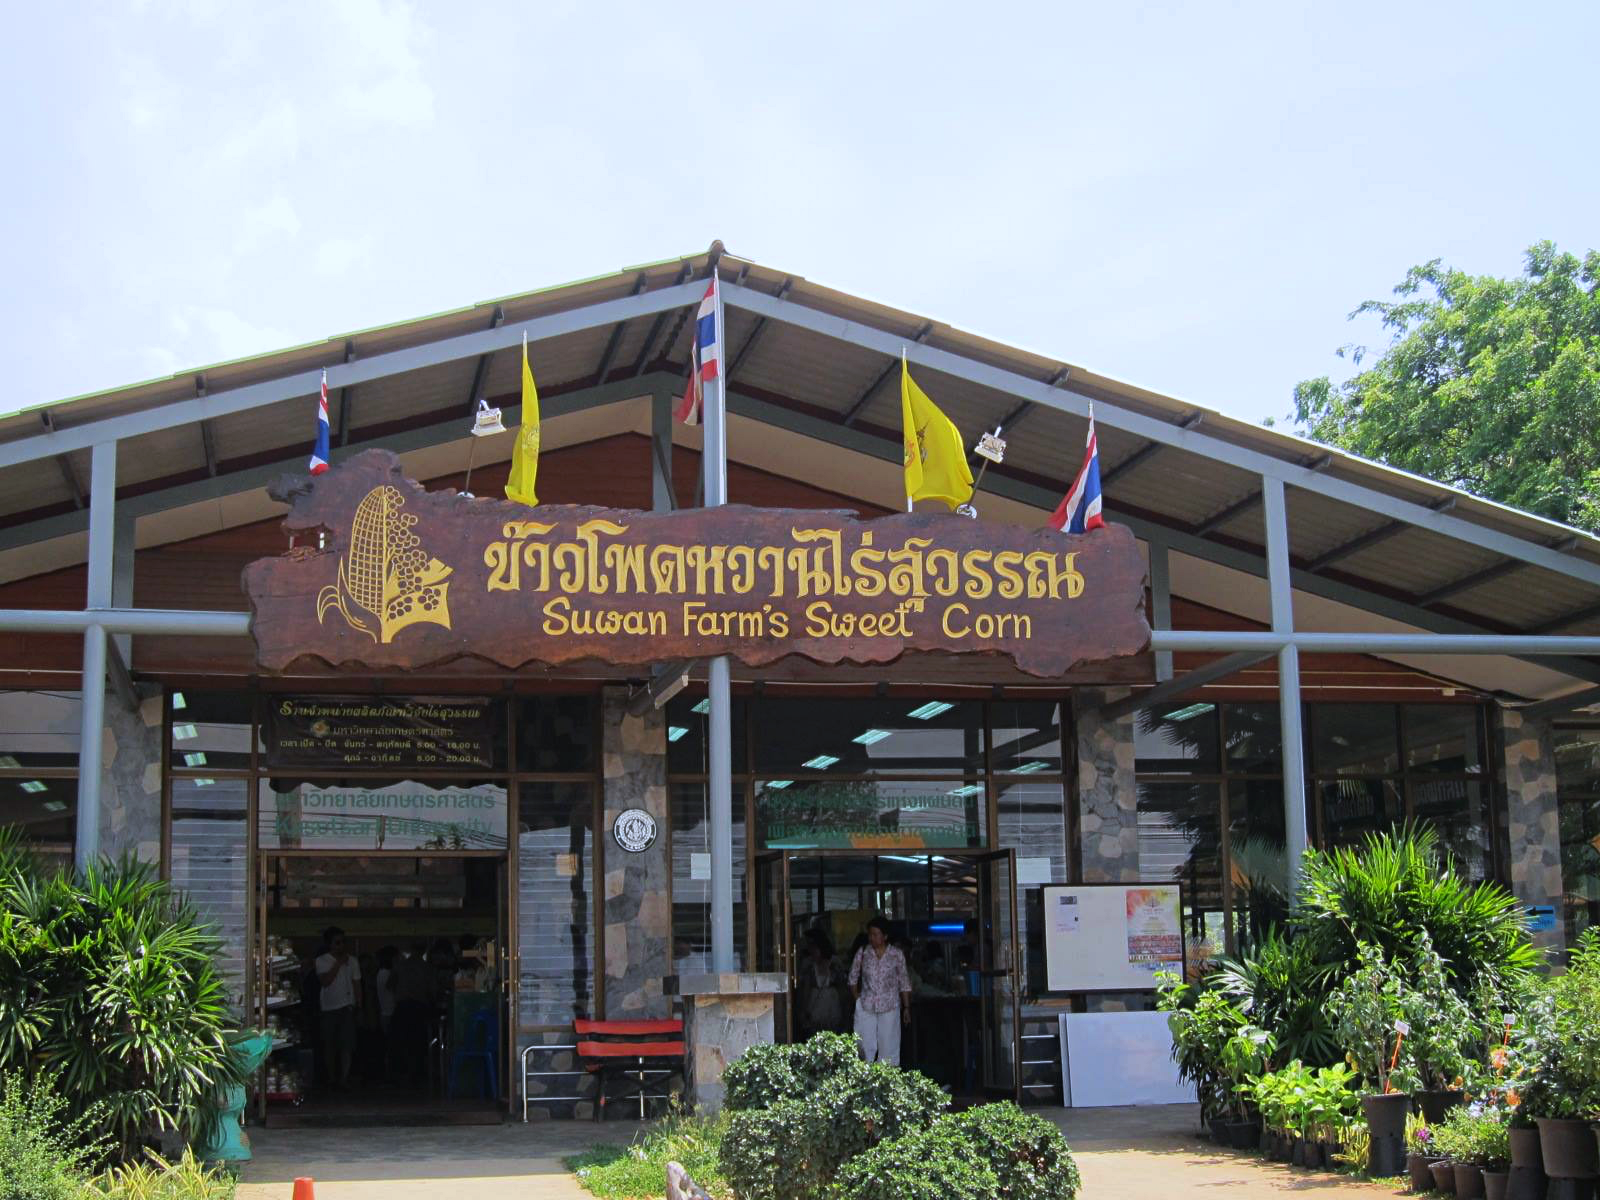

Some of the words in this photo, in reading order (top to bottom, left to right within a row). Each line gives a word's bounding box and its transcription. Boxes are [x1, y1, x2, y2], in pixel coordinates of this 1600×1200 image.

[483, 519, 1085, 613] ข้าวโพดหวานไร่สุวรรณ
[542, 596, 667, 636] Suwan
[805, 600, 914, 638] Sweet
[941, 601, 1033, 639] Corn
